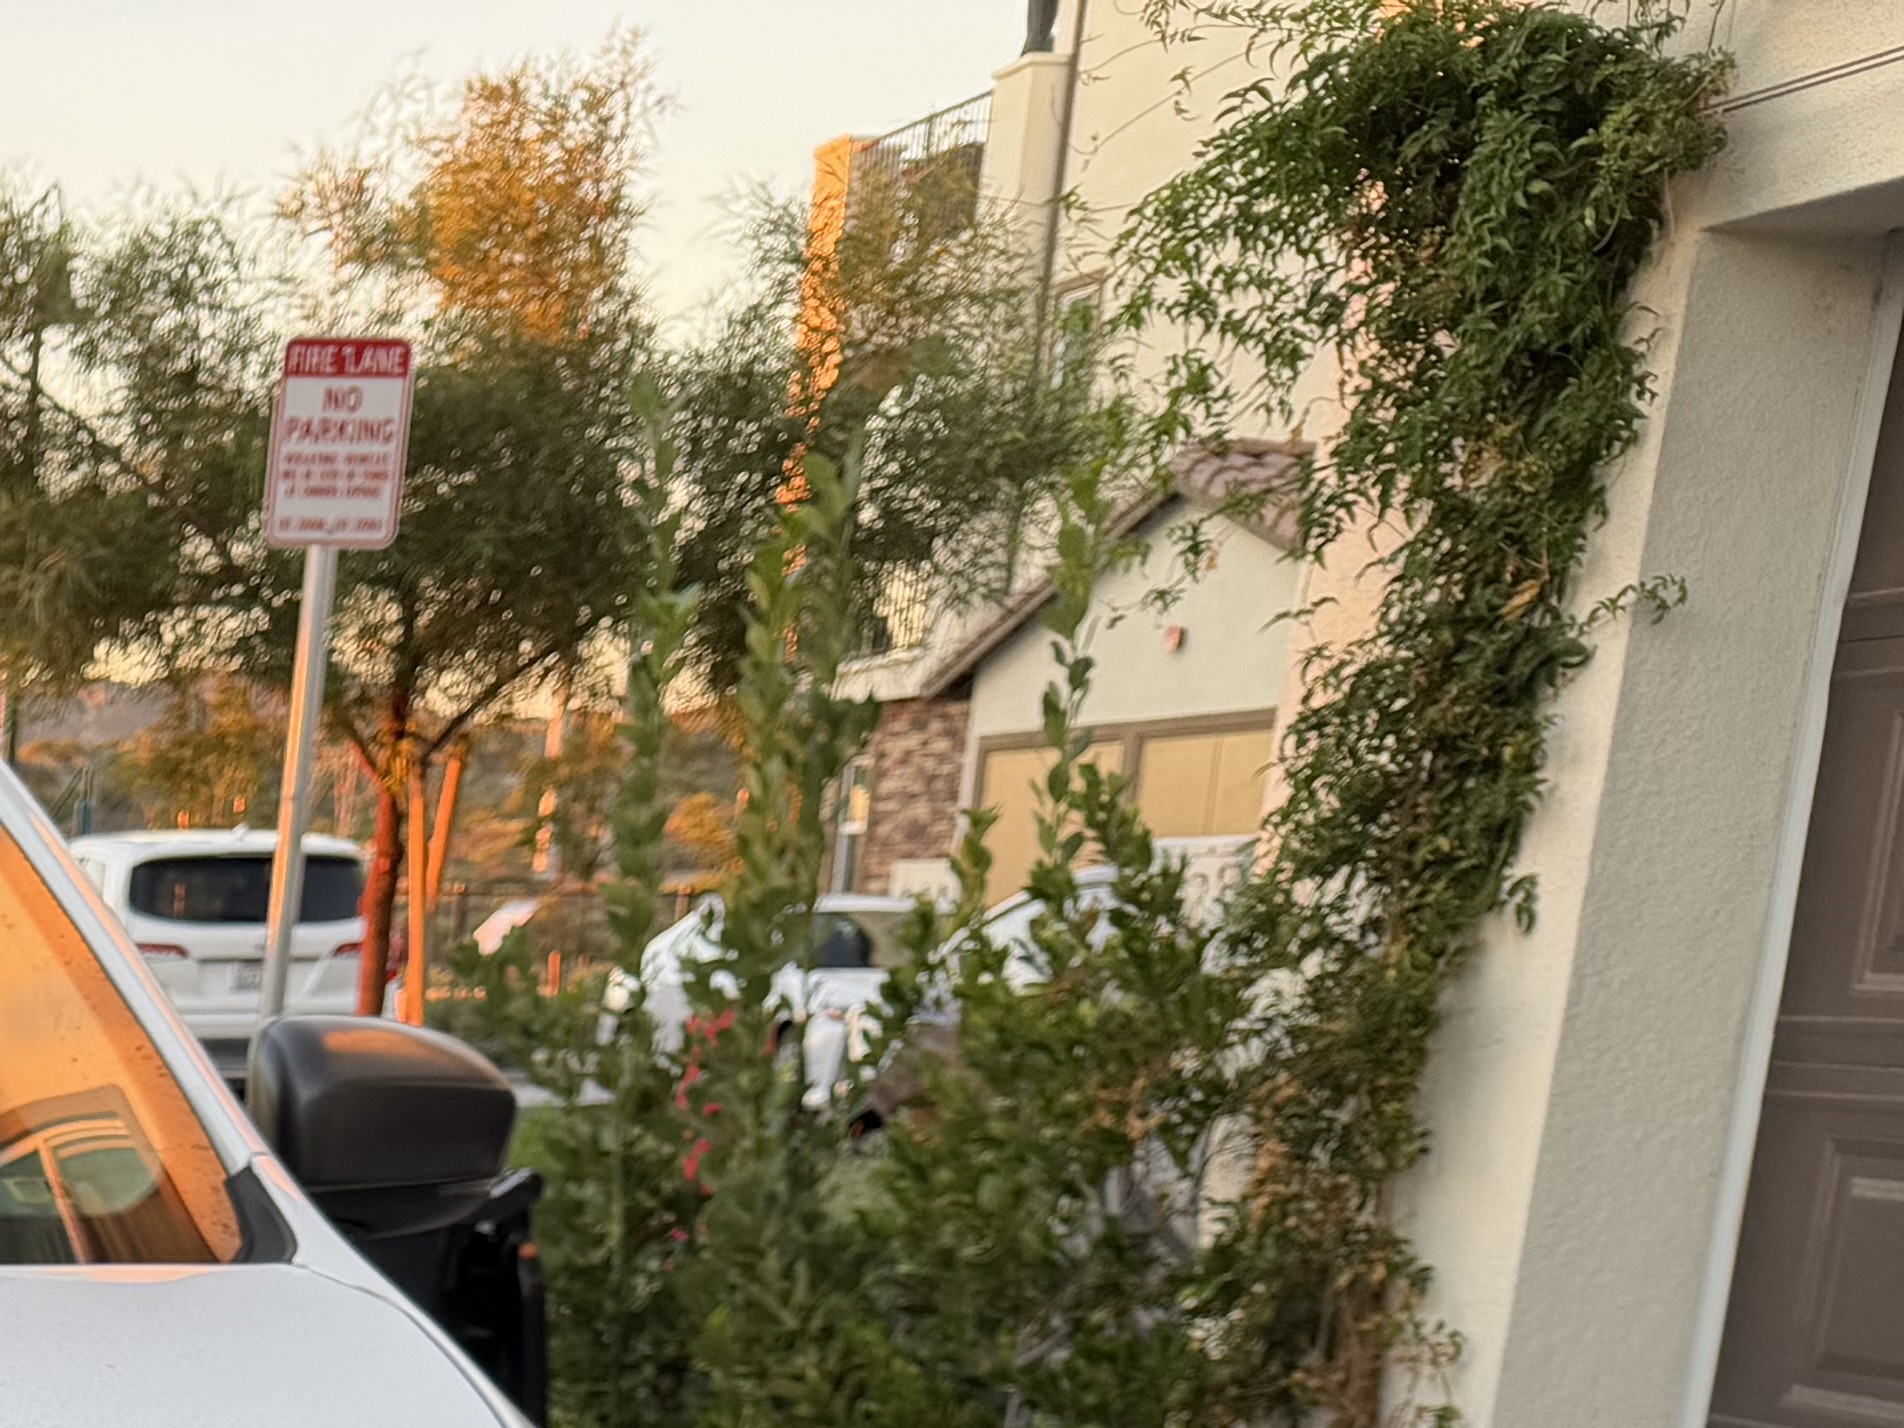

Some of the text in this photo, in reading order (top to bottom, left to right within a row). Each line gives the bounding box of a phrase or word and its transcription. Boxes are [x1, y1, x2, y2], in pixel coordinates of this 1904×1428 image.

[288, 344, 405, 374] FIRE LANE
[323, 386, 364, 413] NO
[284, 417, 395, 445] PARKING
